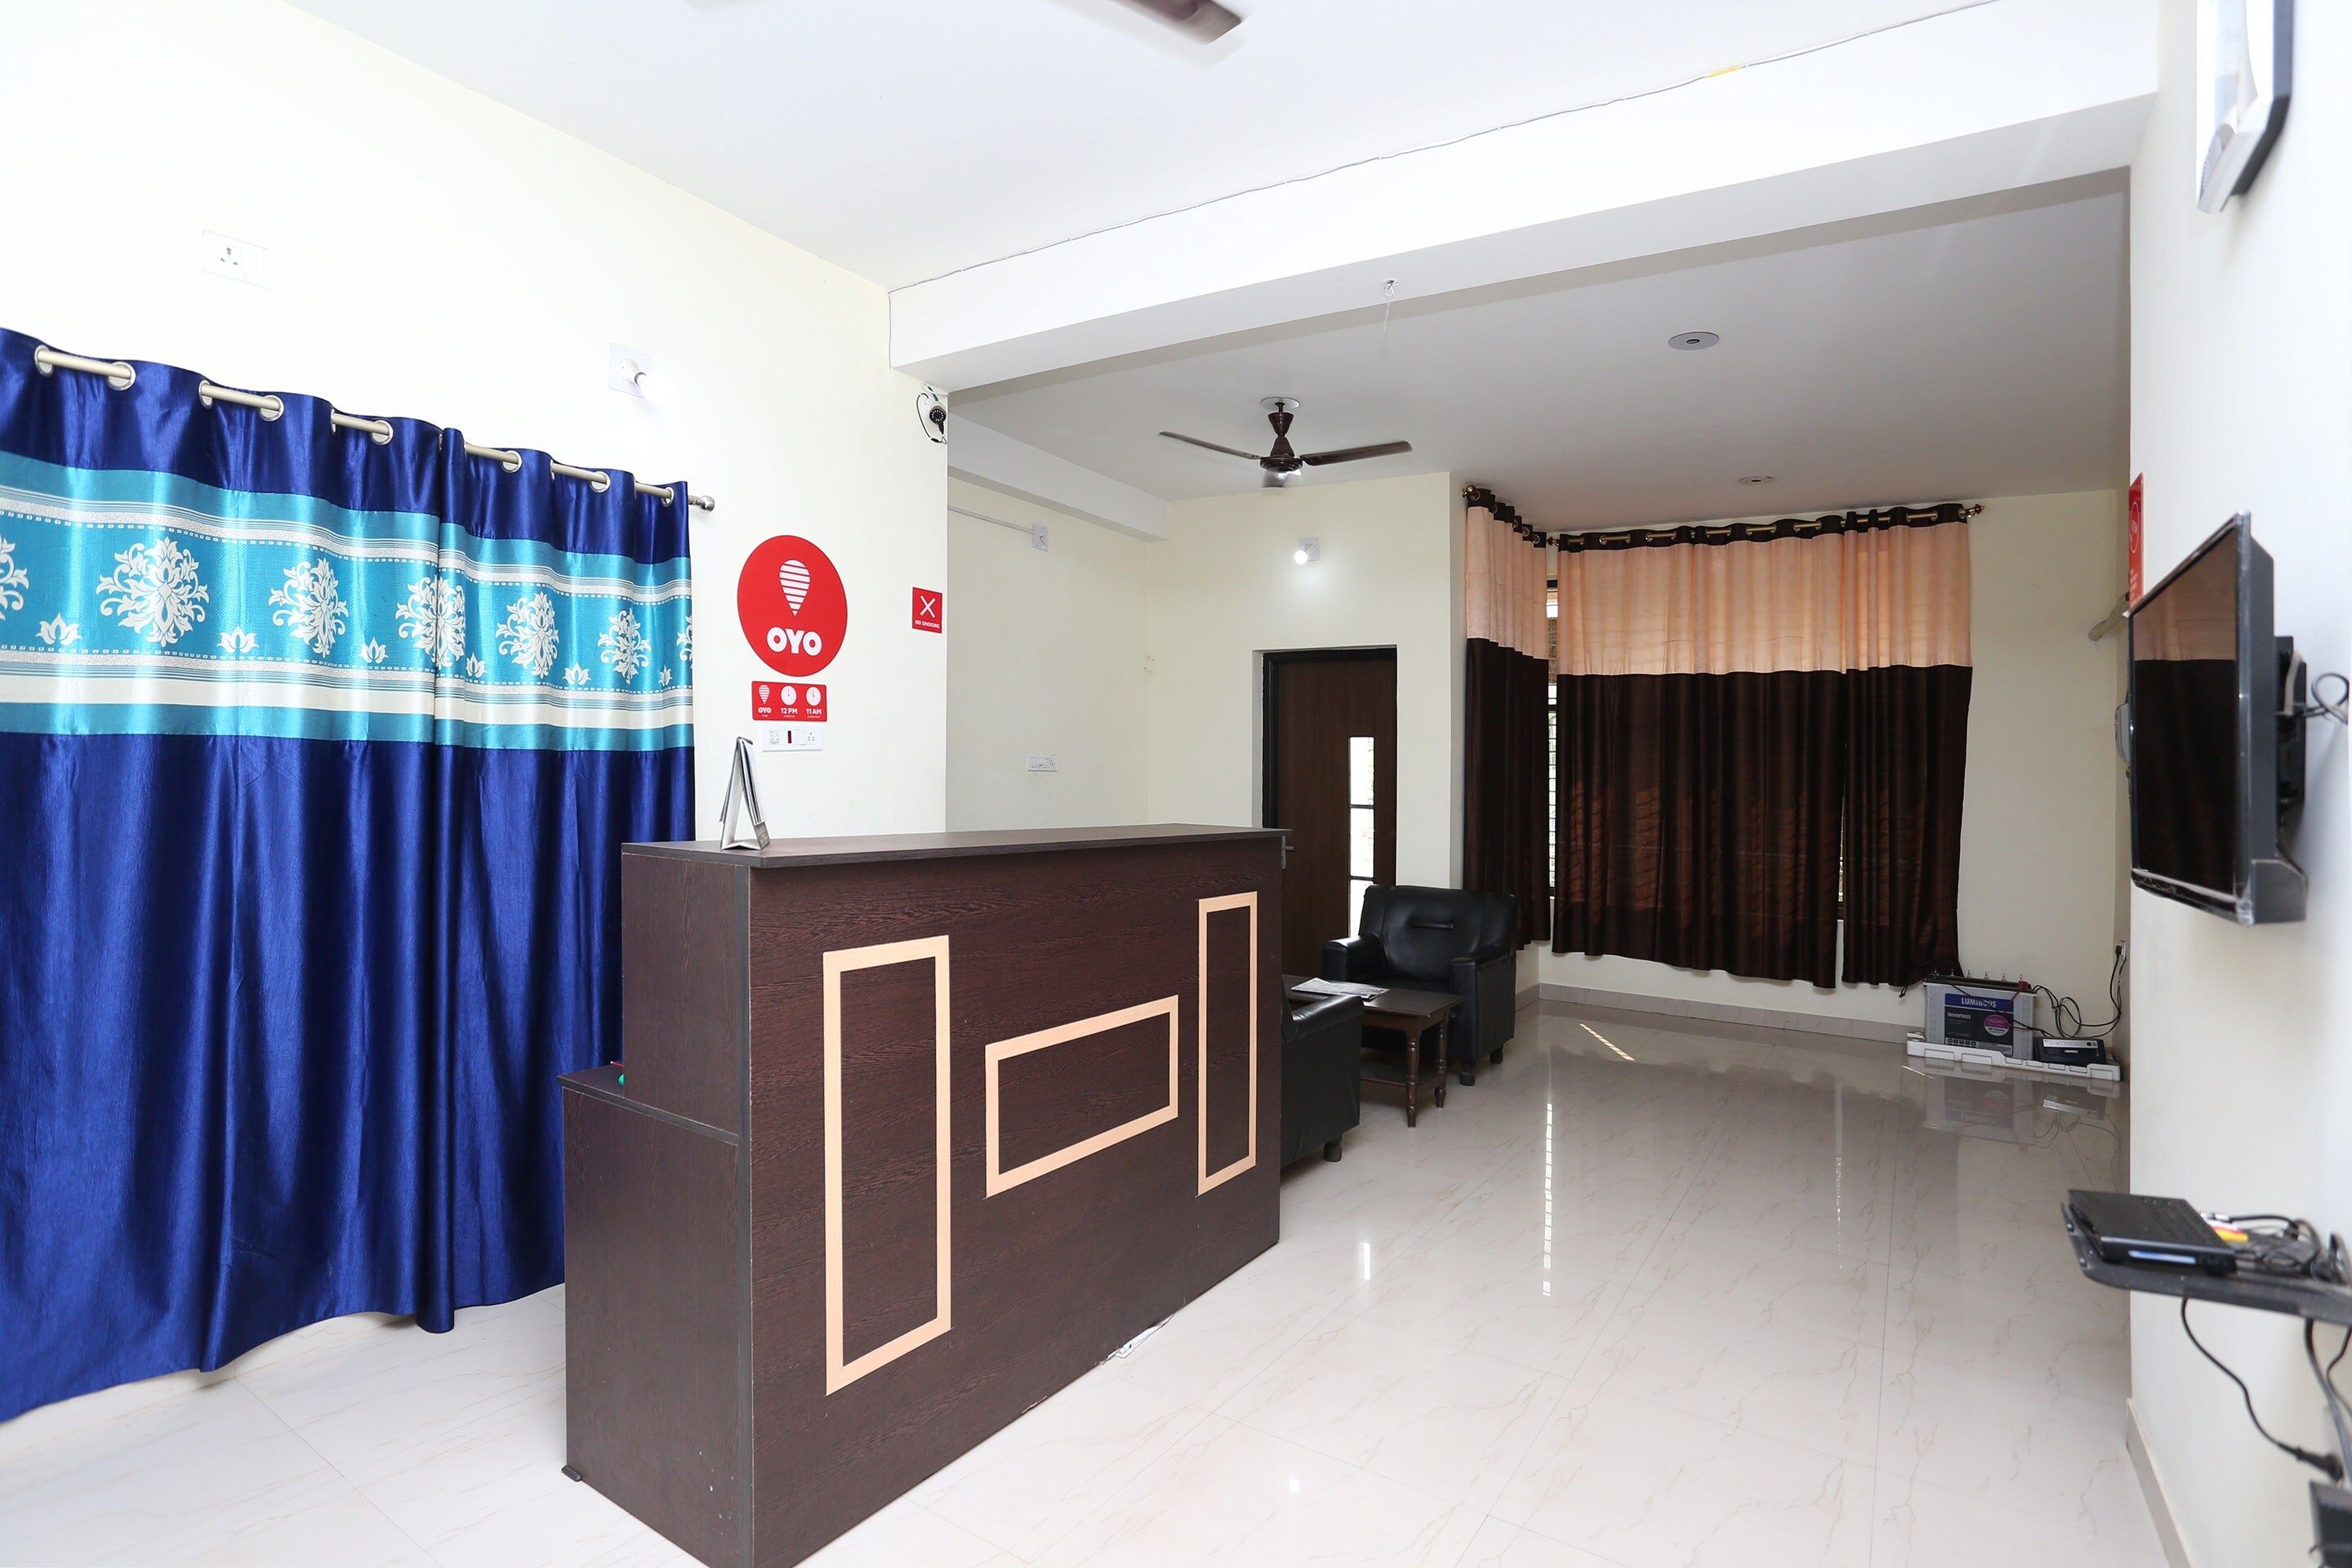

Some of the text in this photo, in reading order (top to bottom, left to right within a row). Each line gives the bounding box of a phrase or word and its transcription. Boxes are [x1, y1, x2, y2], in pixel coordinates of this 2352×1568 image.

[921, 620, 941, 629] SMOKING
[766, 626, 822, 657] OYO
[1961, 997, 1998, 1008] LUMINOUS
